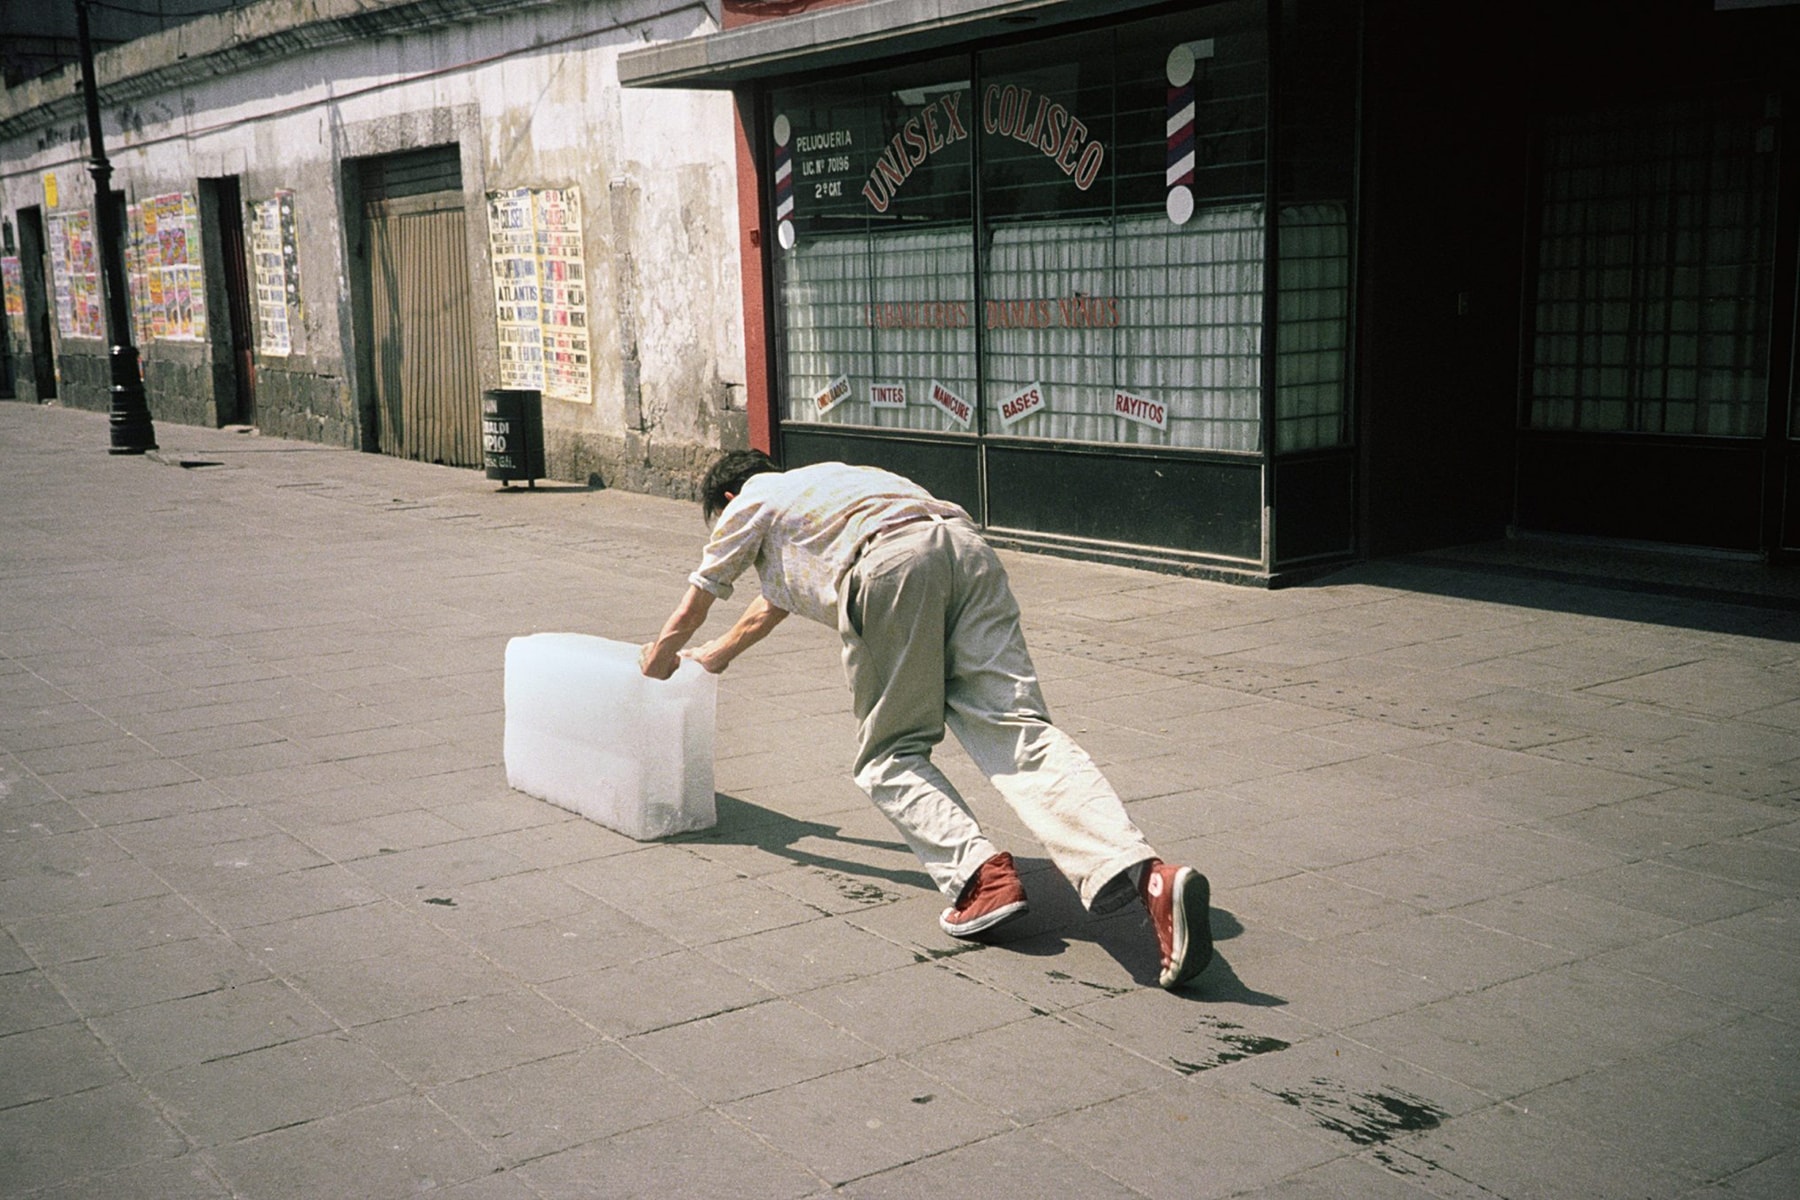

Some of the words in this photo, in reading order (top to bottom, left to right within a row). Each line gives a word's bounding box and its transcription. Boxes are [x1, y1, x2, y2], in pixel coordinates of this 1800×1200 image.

[796, 130, 852, 153] PELUQUERIA
[862, 92, 968, 213] UNISEX
[983, 84, 1104, 191] COLISEO
[986, 299, 1050, 328] DAMAS
[871, 387, 904, 403] TINTES
[1002, 389, 1039, 419] BASES
[1115, 394, 1164, 424] RAYITOS
